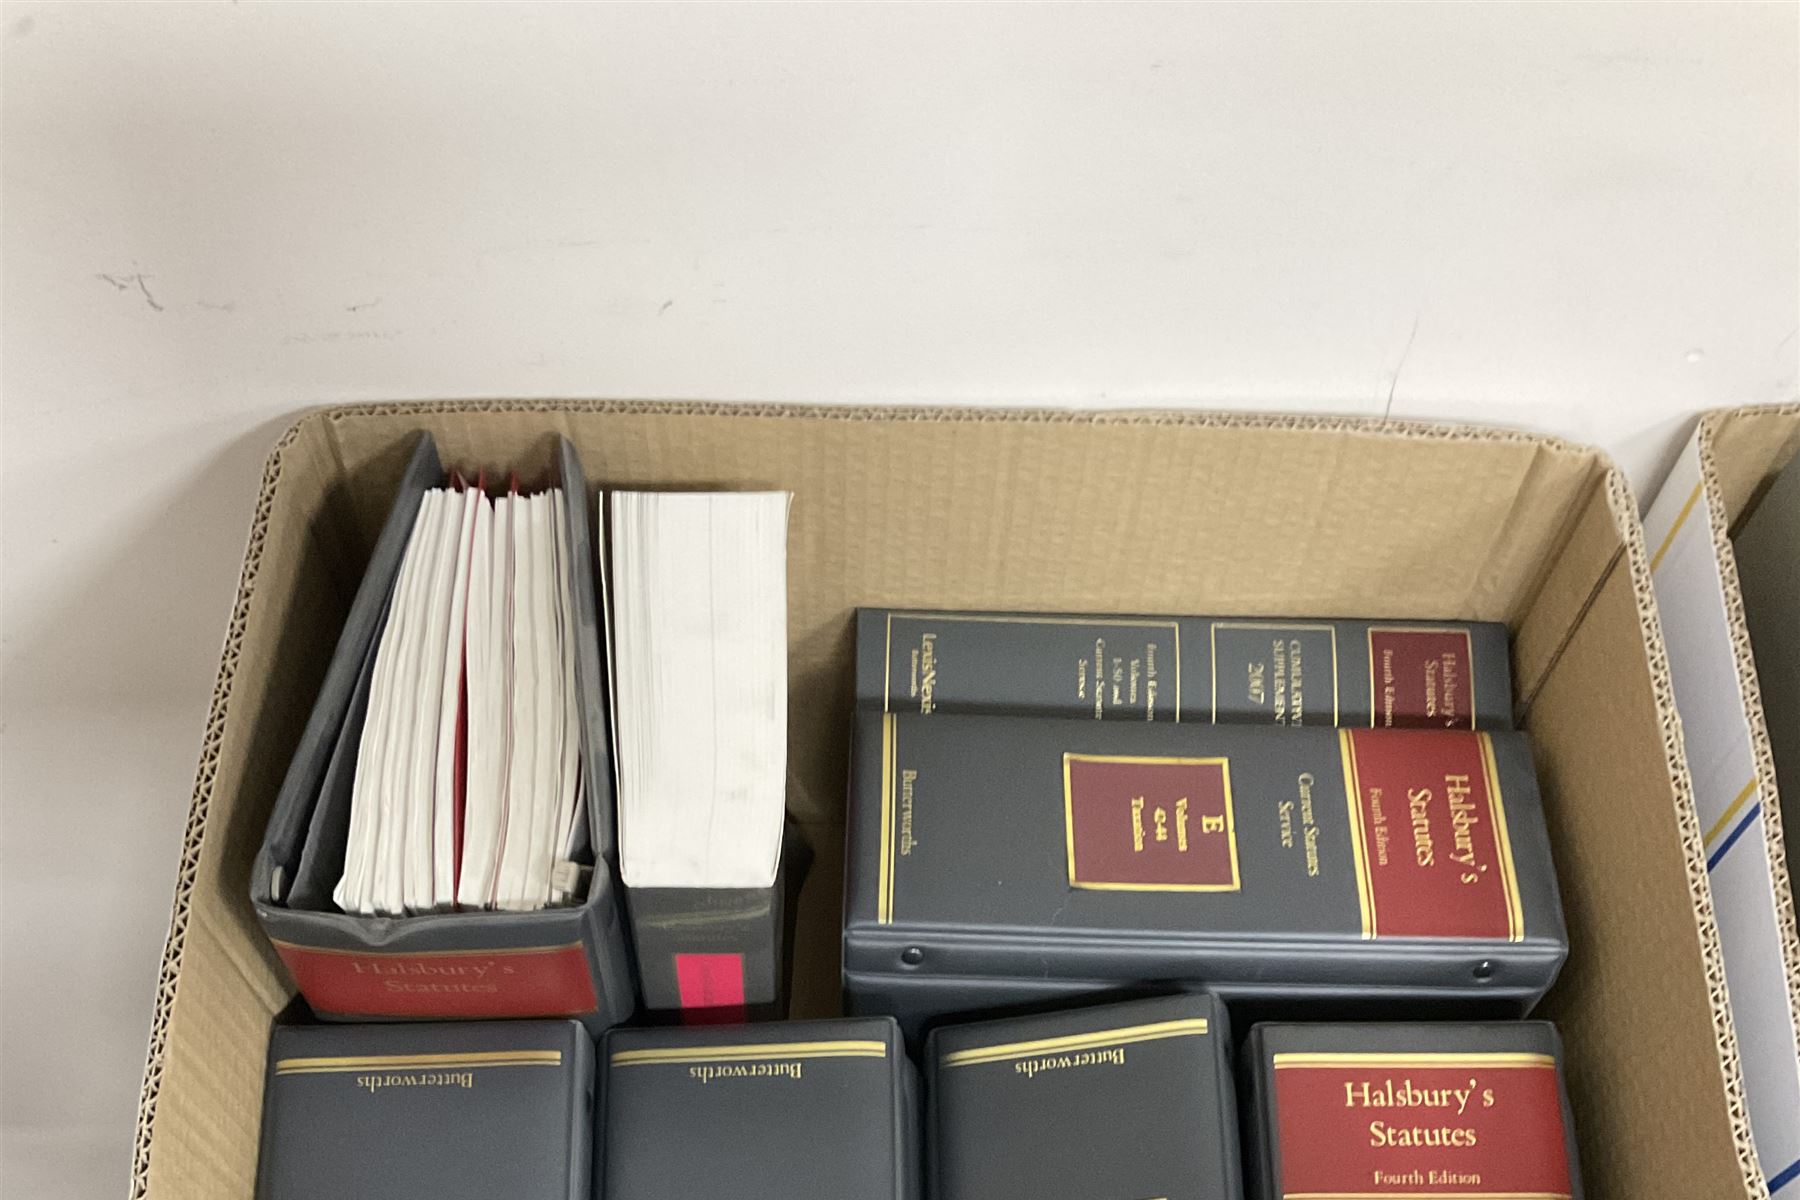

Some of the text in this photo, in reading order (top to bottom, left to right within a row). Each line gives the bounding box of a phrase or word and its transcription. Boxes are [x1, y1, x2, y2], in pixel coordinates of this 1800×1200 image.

[1298, 772, 1314, 825] Current
[1202, 814, 1224, 834] E
[1278, 800, 1294, 849] Service
[1407, 787, 1435, 868] Statutes
[1445, 774, 1488, 885] Halsbury's
[352, 961, 515, 979] Halsbury's
[689, 1062, 802, 1084] Butterworths
[1015, 1048, 1125, 1079] Butterworths
[357, 1072, 473, 1093] Butterworths
[1344, 1079, 1495, 1115] Halsbury's
[1370, 1121, 1477, 1147] Statutes
[1374, 1170, 1481, 1186] Fourth Edition
